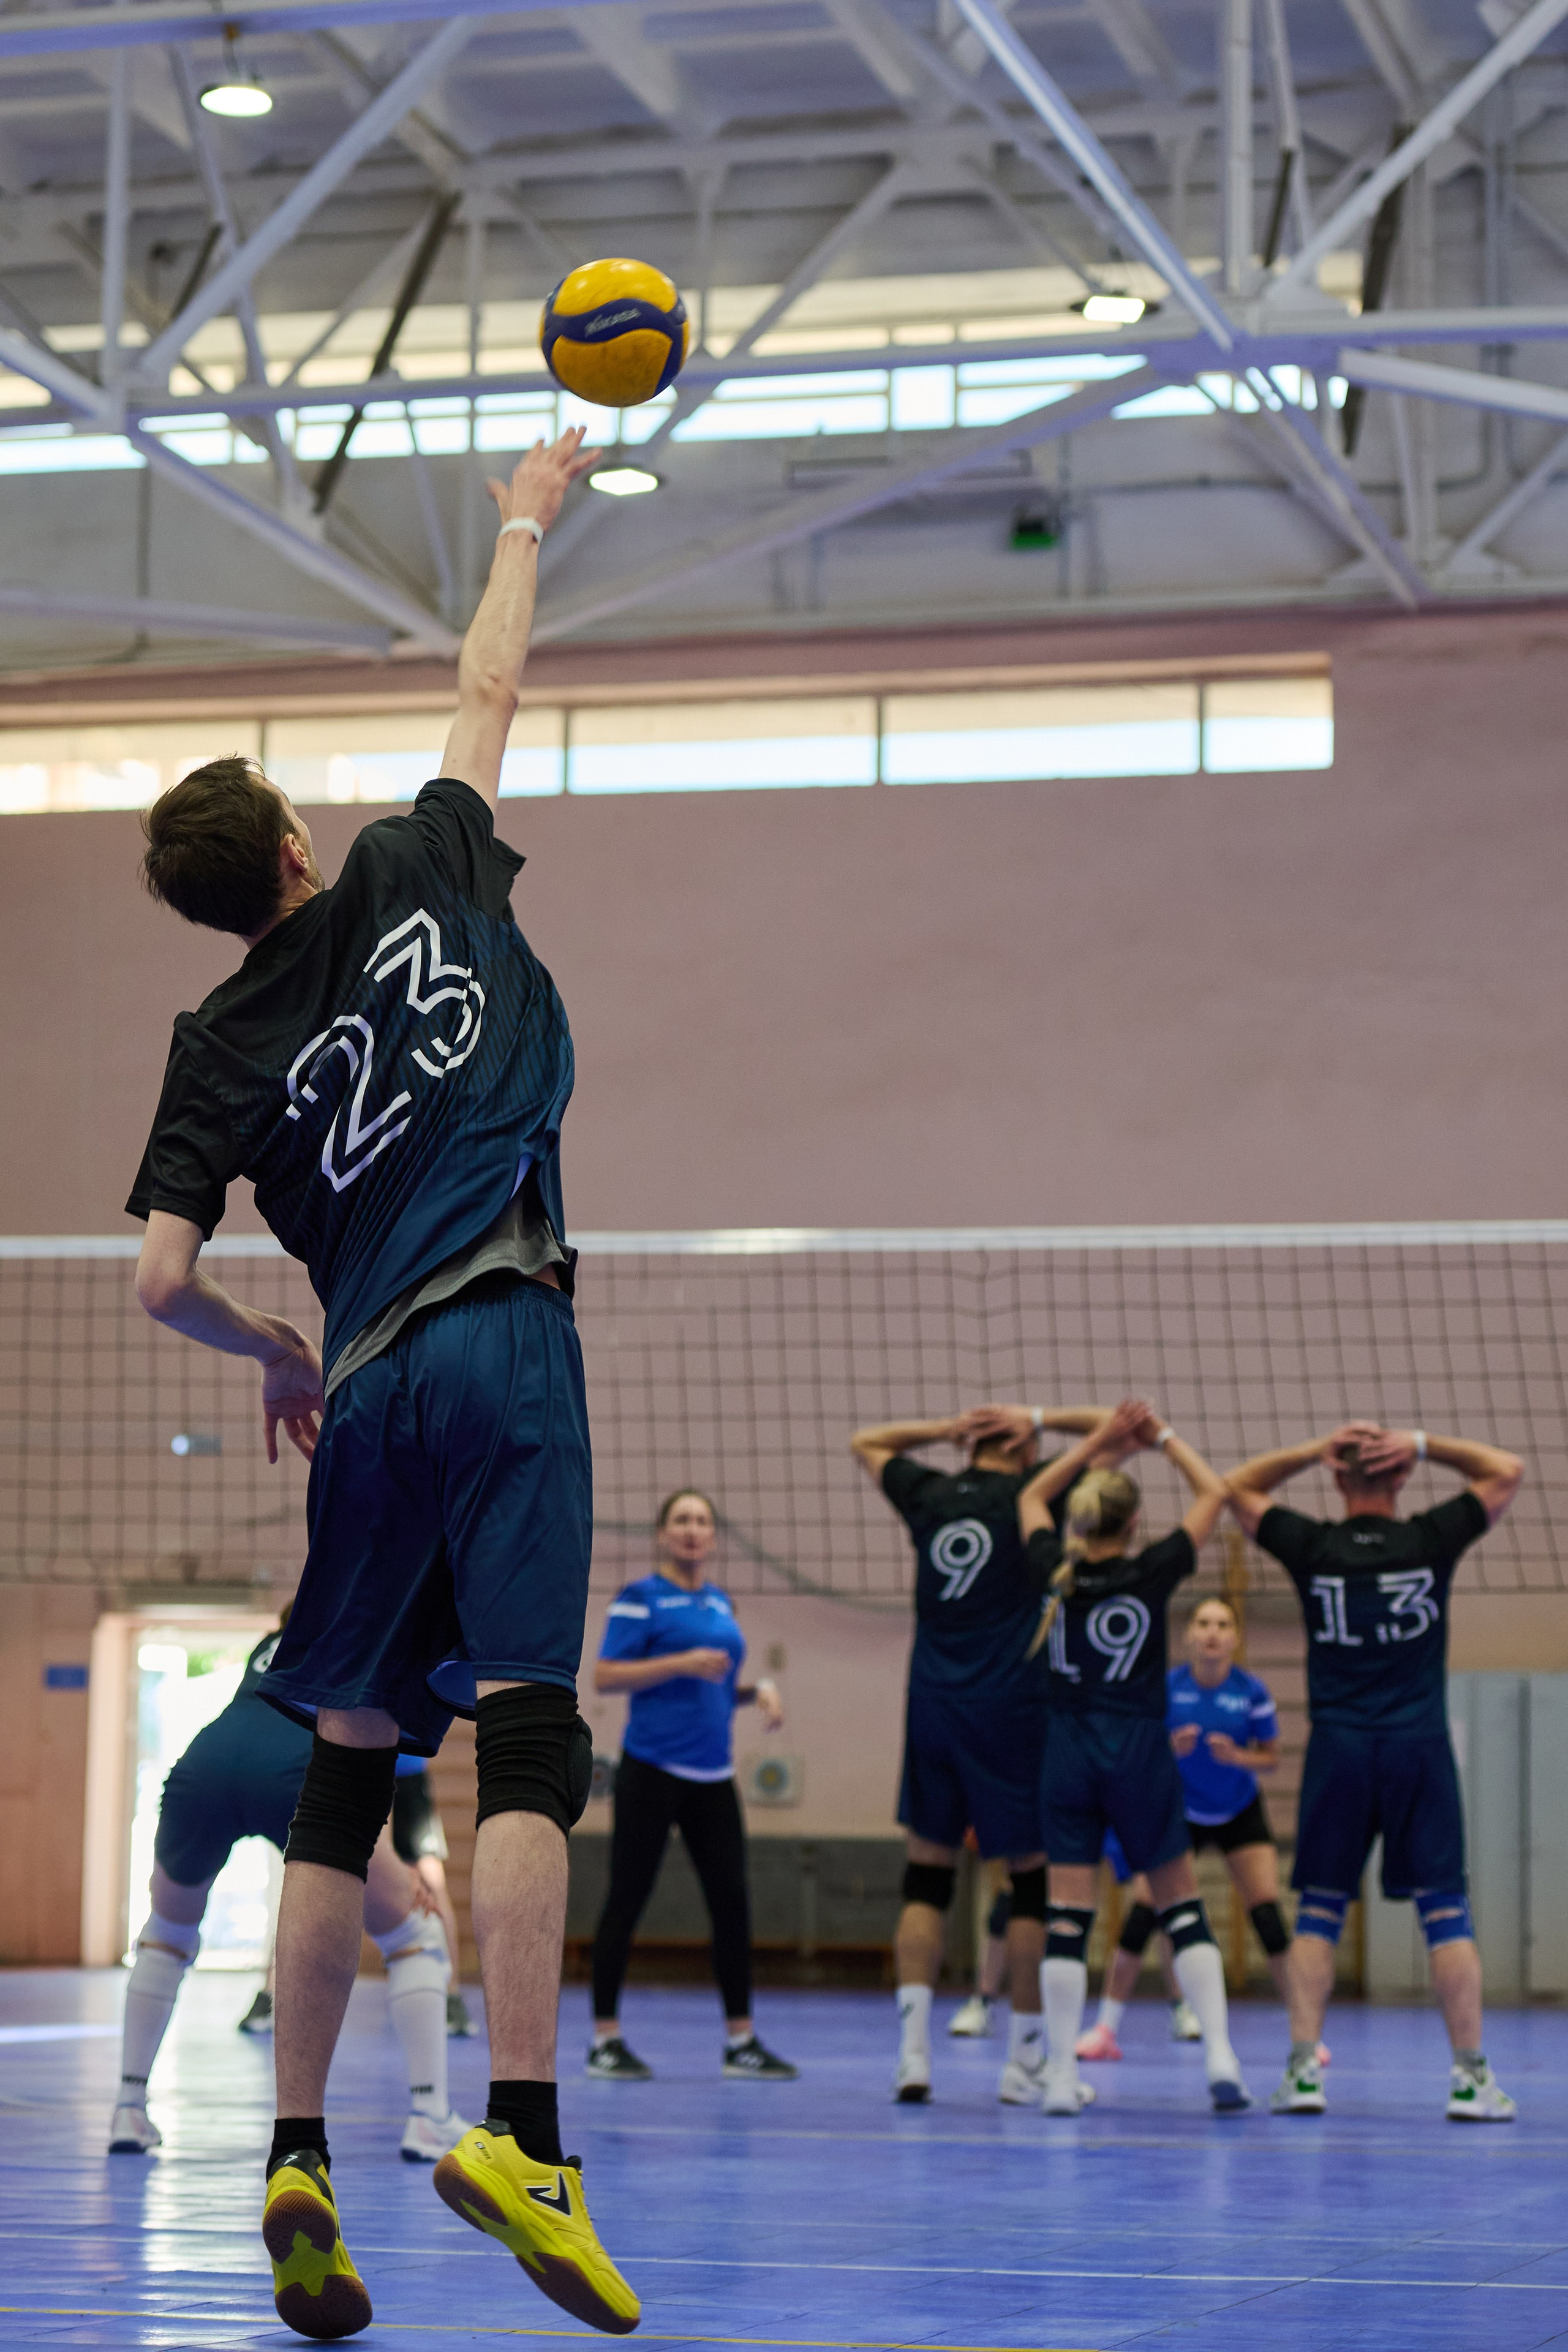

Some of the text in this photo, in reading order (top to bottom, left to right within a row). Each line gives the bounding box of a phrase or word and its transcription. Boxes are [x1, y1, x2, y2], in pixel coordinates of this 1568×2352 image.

[285, 908, 486, 1193] 23
[930, 1517, 993, 1602] 9
[1310, 1566, 1440, 1647] 13
